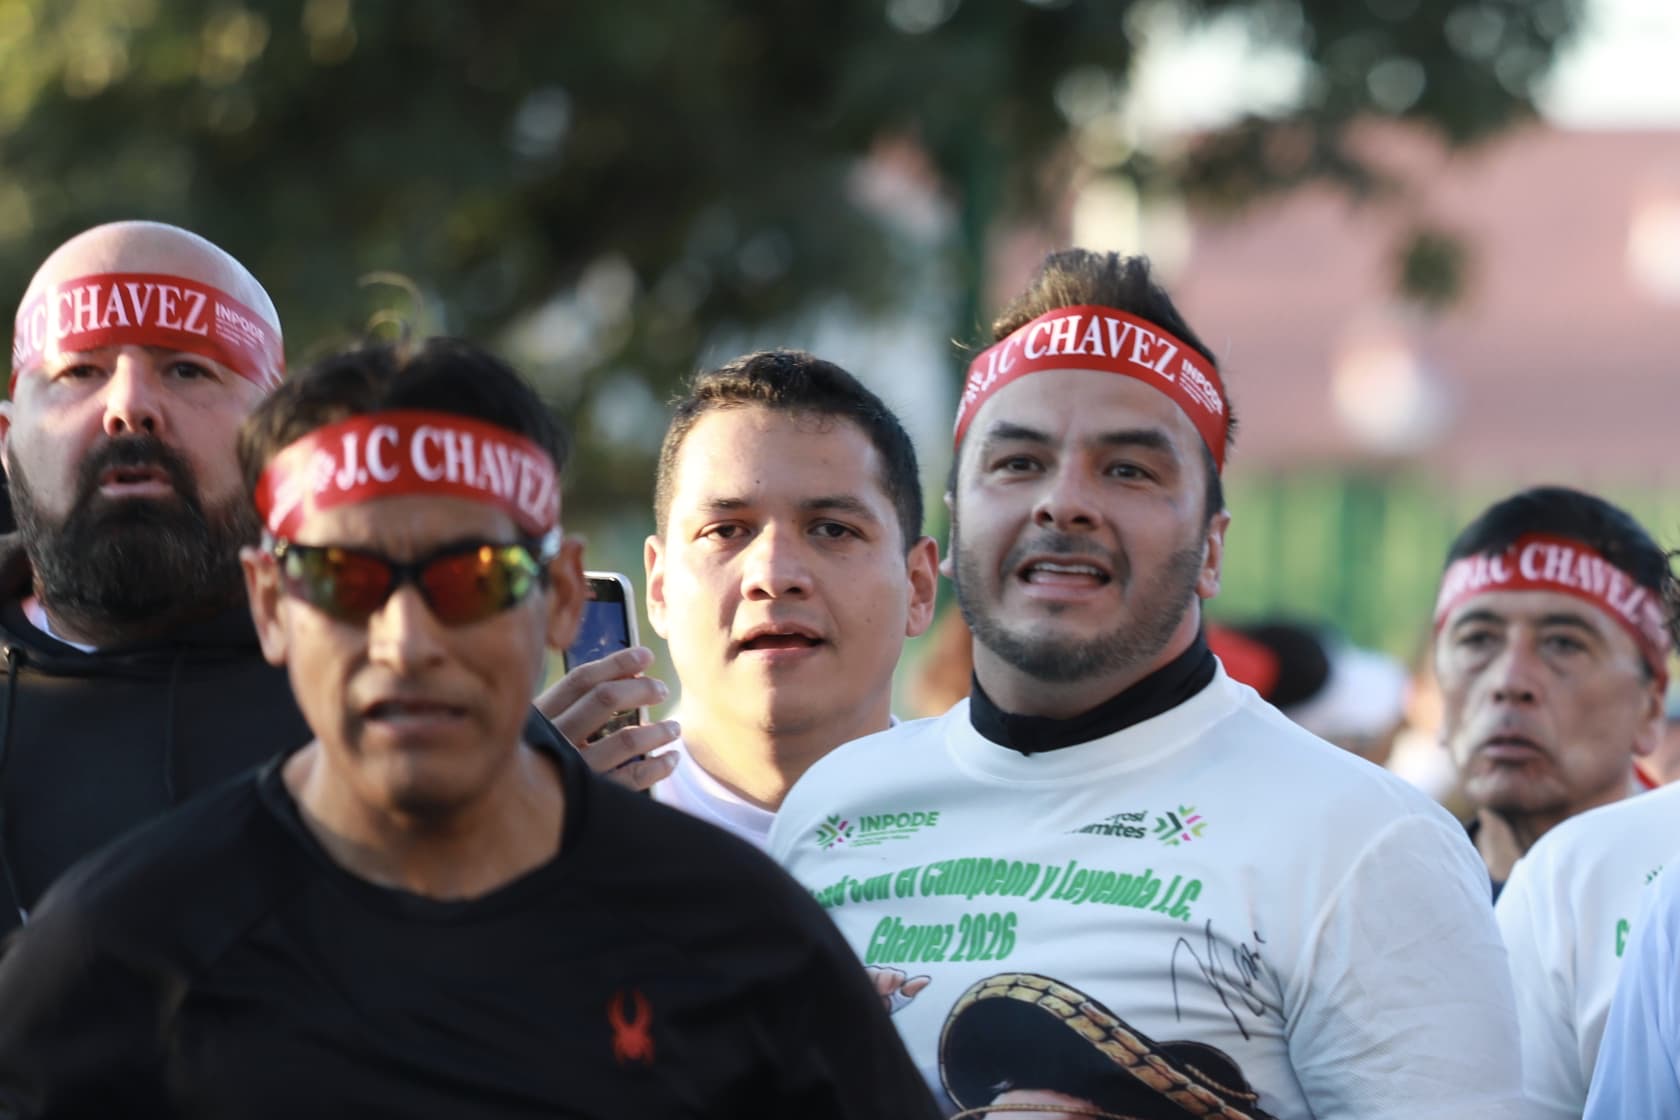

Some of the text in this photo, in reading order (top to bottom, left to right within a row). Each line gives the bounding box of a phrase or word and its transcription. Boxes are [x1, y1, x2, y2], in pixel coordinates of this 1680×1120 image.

[54, 282, 209, 338] CHAVEZ
[214, 301, 265, 345] INPODE
[1023, 314, 1178, 382] CHAVEZ
[335, 424, 399, 491] J.C
[409, 425, 556, 528] CHAVEZ
[1518, 541, 1648, 623] CHAVEZ
[860, 811, 939, 832] INPODE
[1029, 865, 1062, 902] y
[1050, 859, 1162, 909] Leyenda
[865, 912, 1018, 964] Chavez 2026
